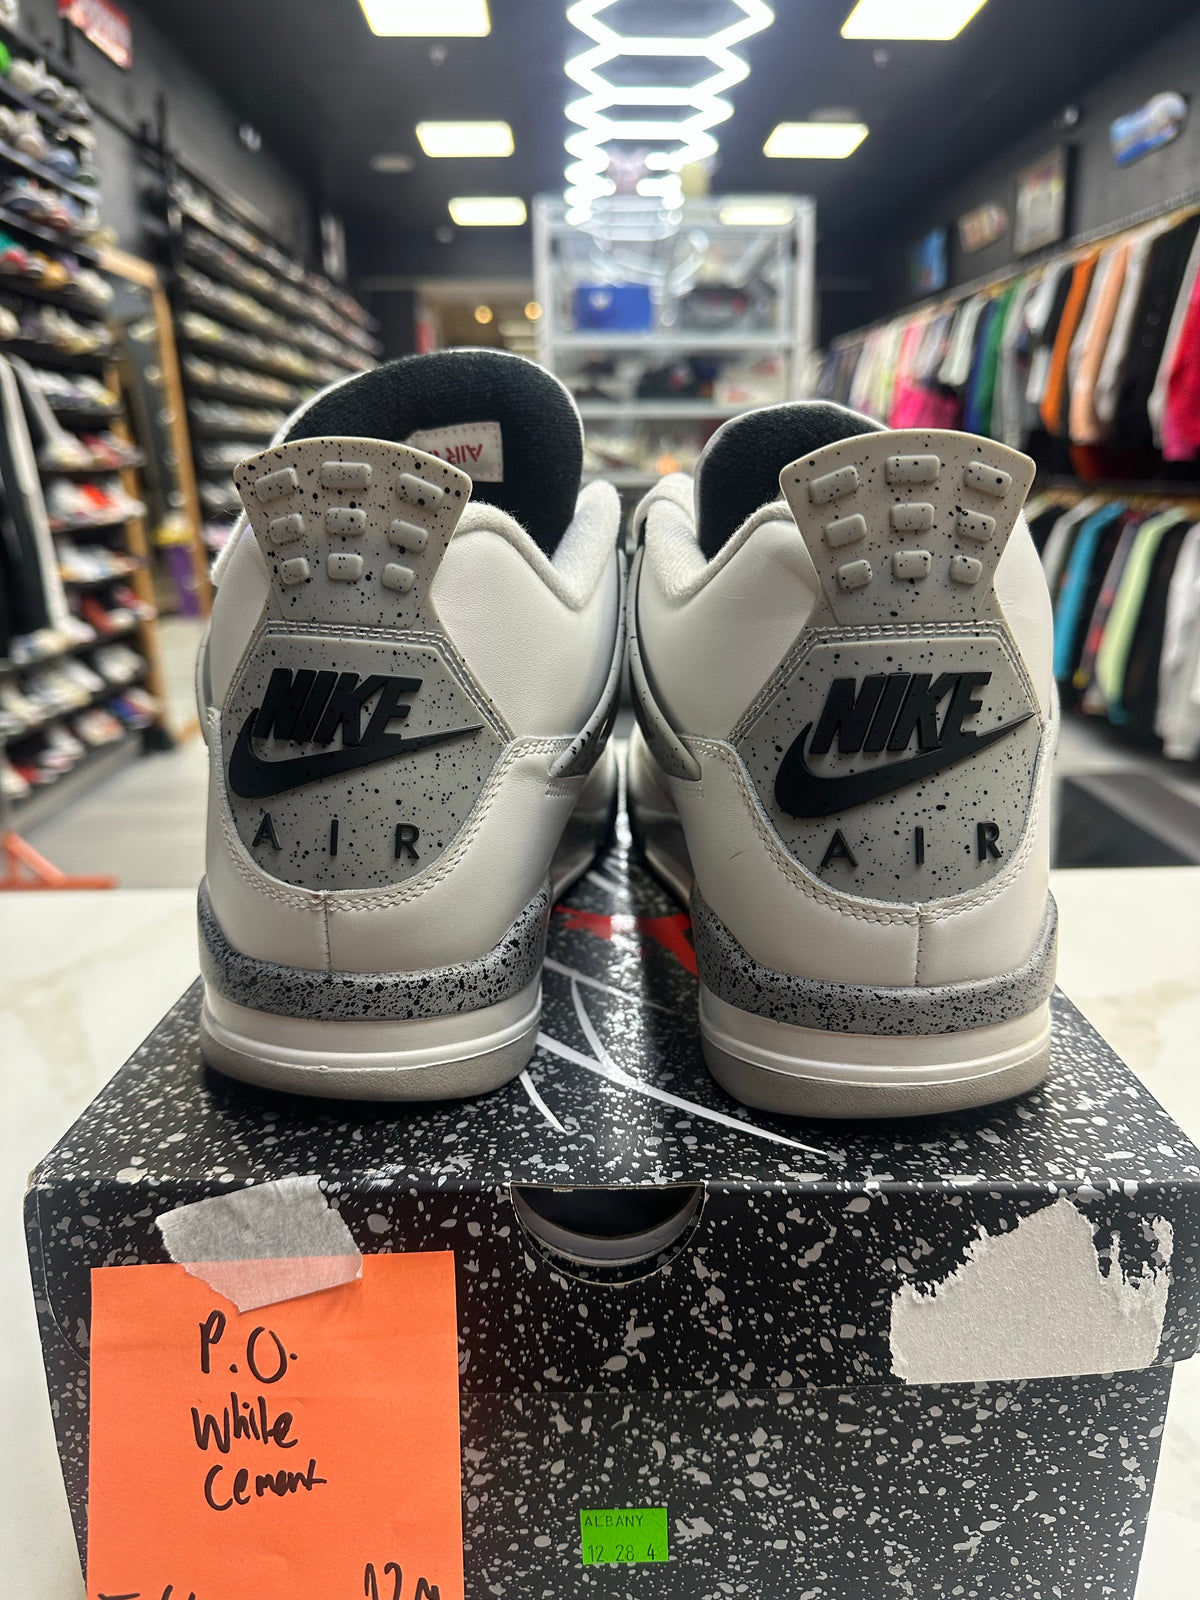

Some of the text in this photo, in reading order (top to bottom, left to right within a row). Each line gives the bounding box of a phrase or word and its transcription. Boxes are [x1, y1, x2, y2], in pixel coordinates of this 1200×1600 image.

[445, 443, 483, 465] AIR
[252, 667, 423, 749] NIKE
[808, 671, 992, 755] NIKE
[252, 812, 420, 860] AIR
[820, 821, 1002, 867] AIR
[199, 1309, 298, 1384] P.O.
[204, 1458, 328, 1511] Cement
[584, 1514, 644, 1528] ALBANY
[588, 1543, 656, 1562] 12 28 4
